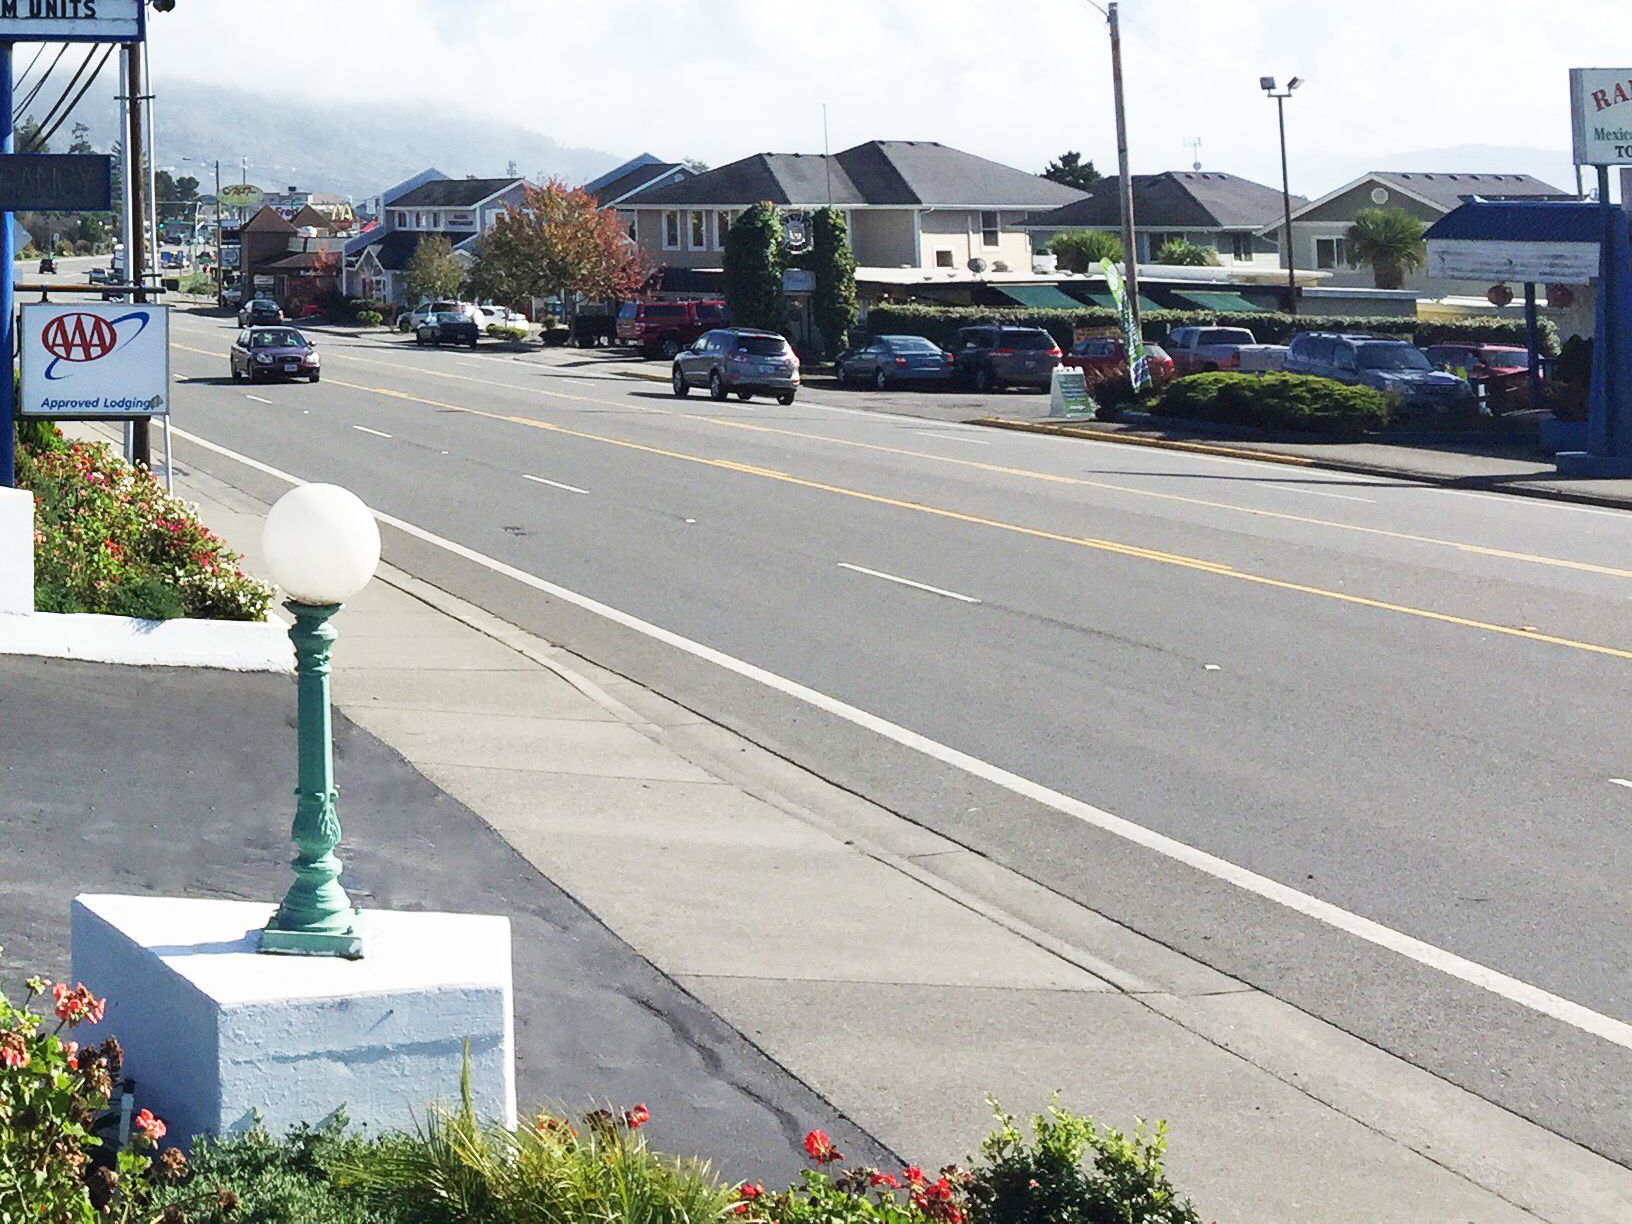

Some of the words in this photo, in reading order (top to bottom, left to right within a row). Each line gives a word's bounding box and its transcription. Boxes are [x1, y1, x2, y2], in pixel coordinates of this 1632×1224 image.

[29, 0, 96, 18] UNITS
[1591, 80, 1632, 112] RA
[50, 314, 109, 361] AAA
[41, 397, 100, 410] Approved
[104, 397, 151, 411] Lodging
